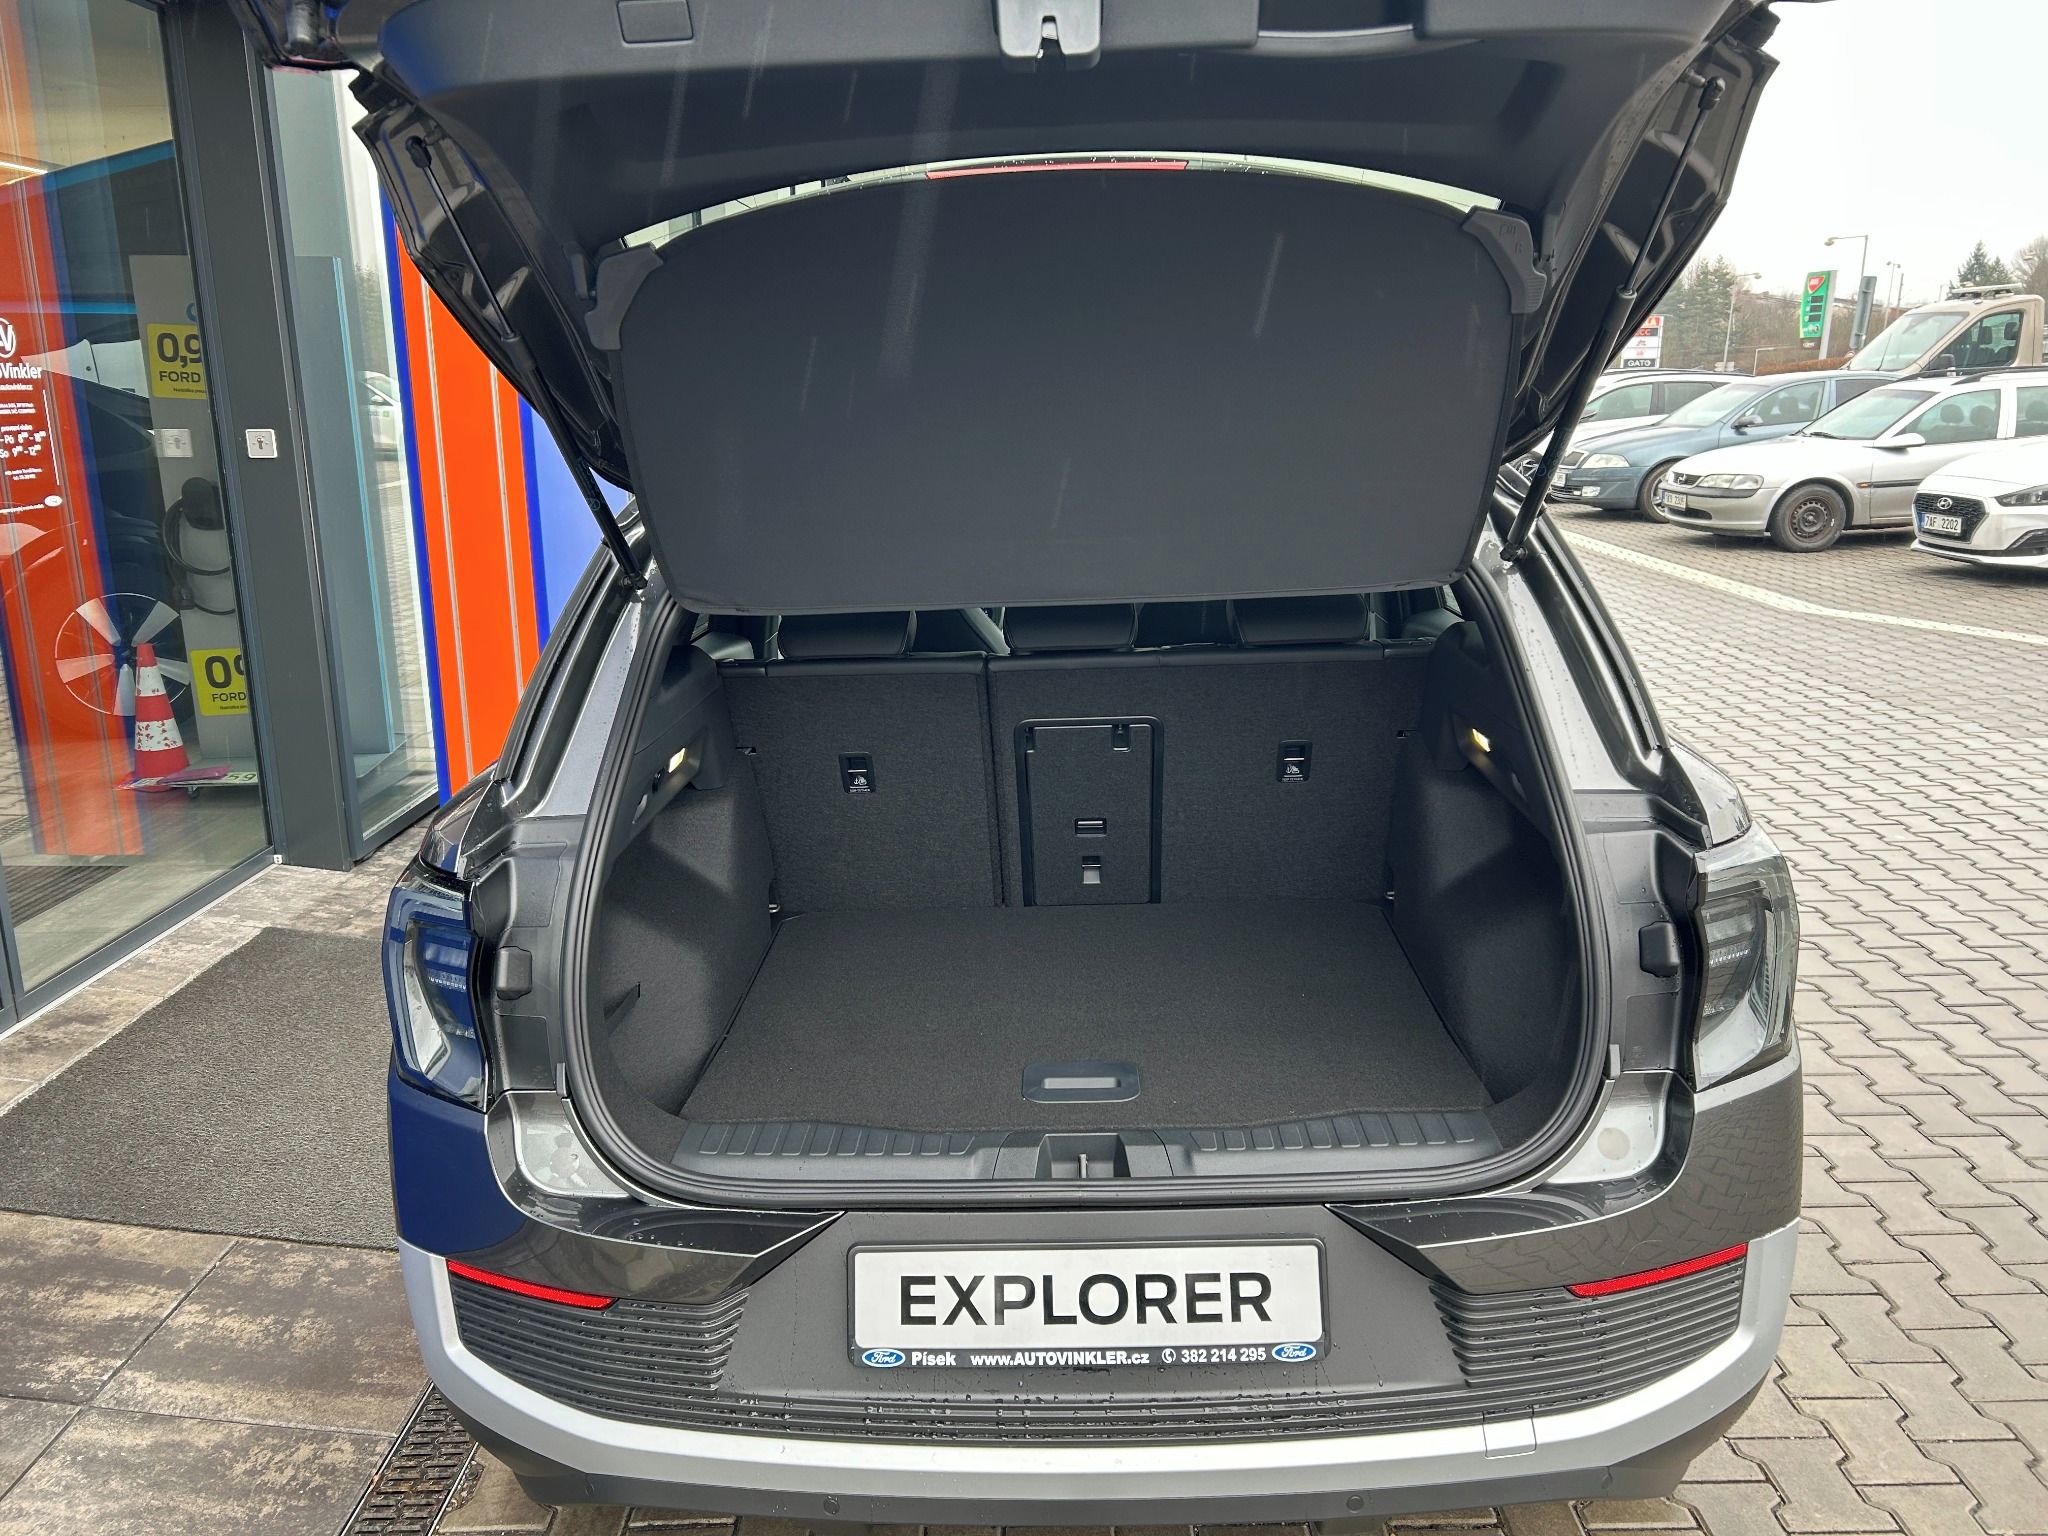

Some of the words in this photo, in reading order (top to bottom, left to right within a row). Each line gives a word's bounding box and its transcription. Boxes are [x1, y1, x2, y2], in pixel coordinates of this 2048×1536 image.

[1627, 359, 1651, 367] GATO
[159, 370, 201, 383] FORD
[1942, 518, 1959, 531] 2202
[212, 691, 247, 702] FORD
[900, 1272, 1272, 1326] EXPLORER
[911, 1351, 957, 1366] Písek
[970, 1350, 1150, 1367] www.AUTOVINKLER.cz
[1181, 1349, 1208, 1363] 382
[1210, 1348, 1237, 1363] 214
[1239, 1347, 1267, 1362] 295
